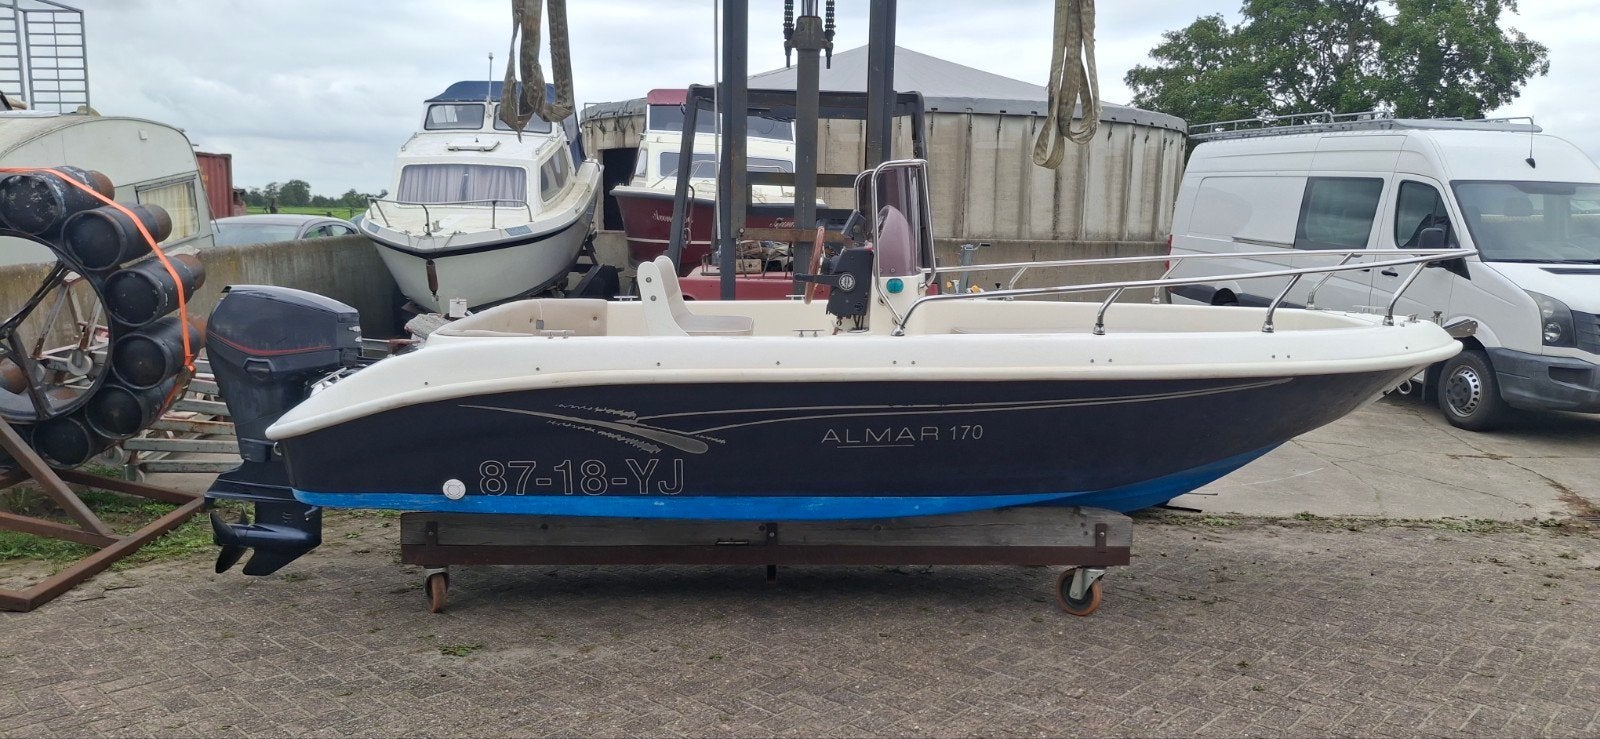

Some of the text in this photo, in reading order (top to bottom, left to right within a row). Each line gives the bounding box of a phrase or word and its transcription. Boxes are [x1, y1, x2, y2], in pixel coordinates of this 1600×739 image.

[821, 424, 984, 443] ALMAR 170
[479, 458, 684, 496] 87-18-YJ
